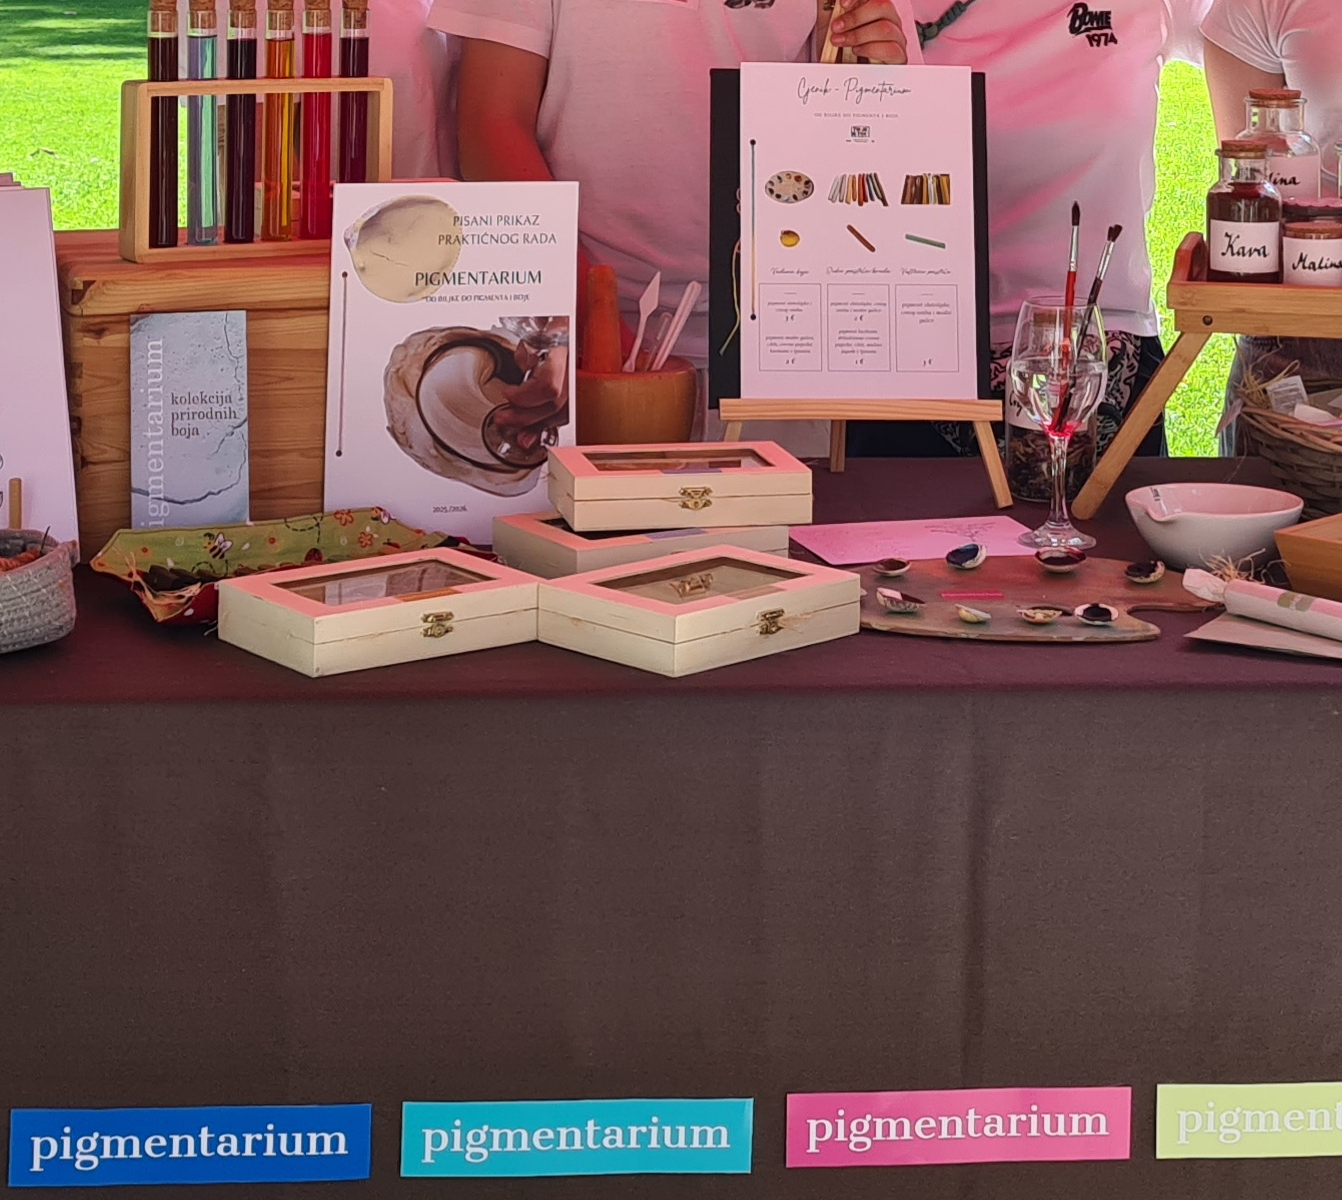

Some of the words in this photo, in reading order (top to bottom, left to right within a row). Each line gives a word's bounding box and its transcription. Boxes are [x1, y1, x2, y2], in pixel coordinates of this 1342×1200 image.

[1086, 31, 1118, 47] 1974
[453, 215, 493, 227] PISANI
[497, 215, 540, 226] PRIKAZ
[523, 233, 557, 244] RADA
[1221, 232, 1269, 258] Kava
[415, 270, 542, 286] PIGMENTARIUM
[171, 390, 233, 406] kolekcija
[171, 407, 237, 422] prirodnih
[141, 339, 169, 529] igmentarium
[171, 422, 200, 439] boja
[805, 1104, 1110, 1151] pigmentarium
[29, 1122, 349, 1171] pigmentarium
[421, 1116, 731, 1164] pigmentarium
